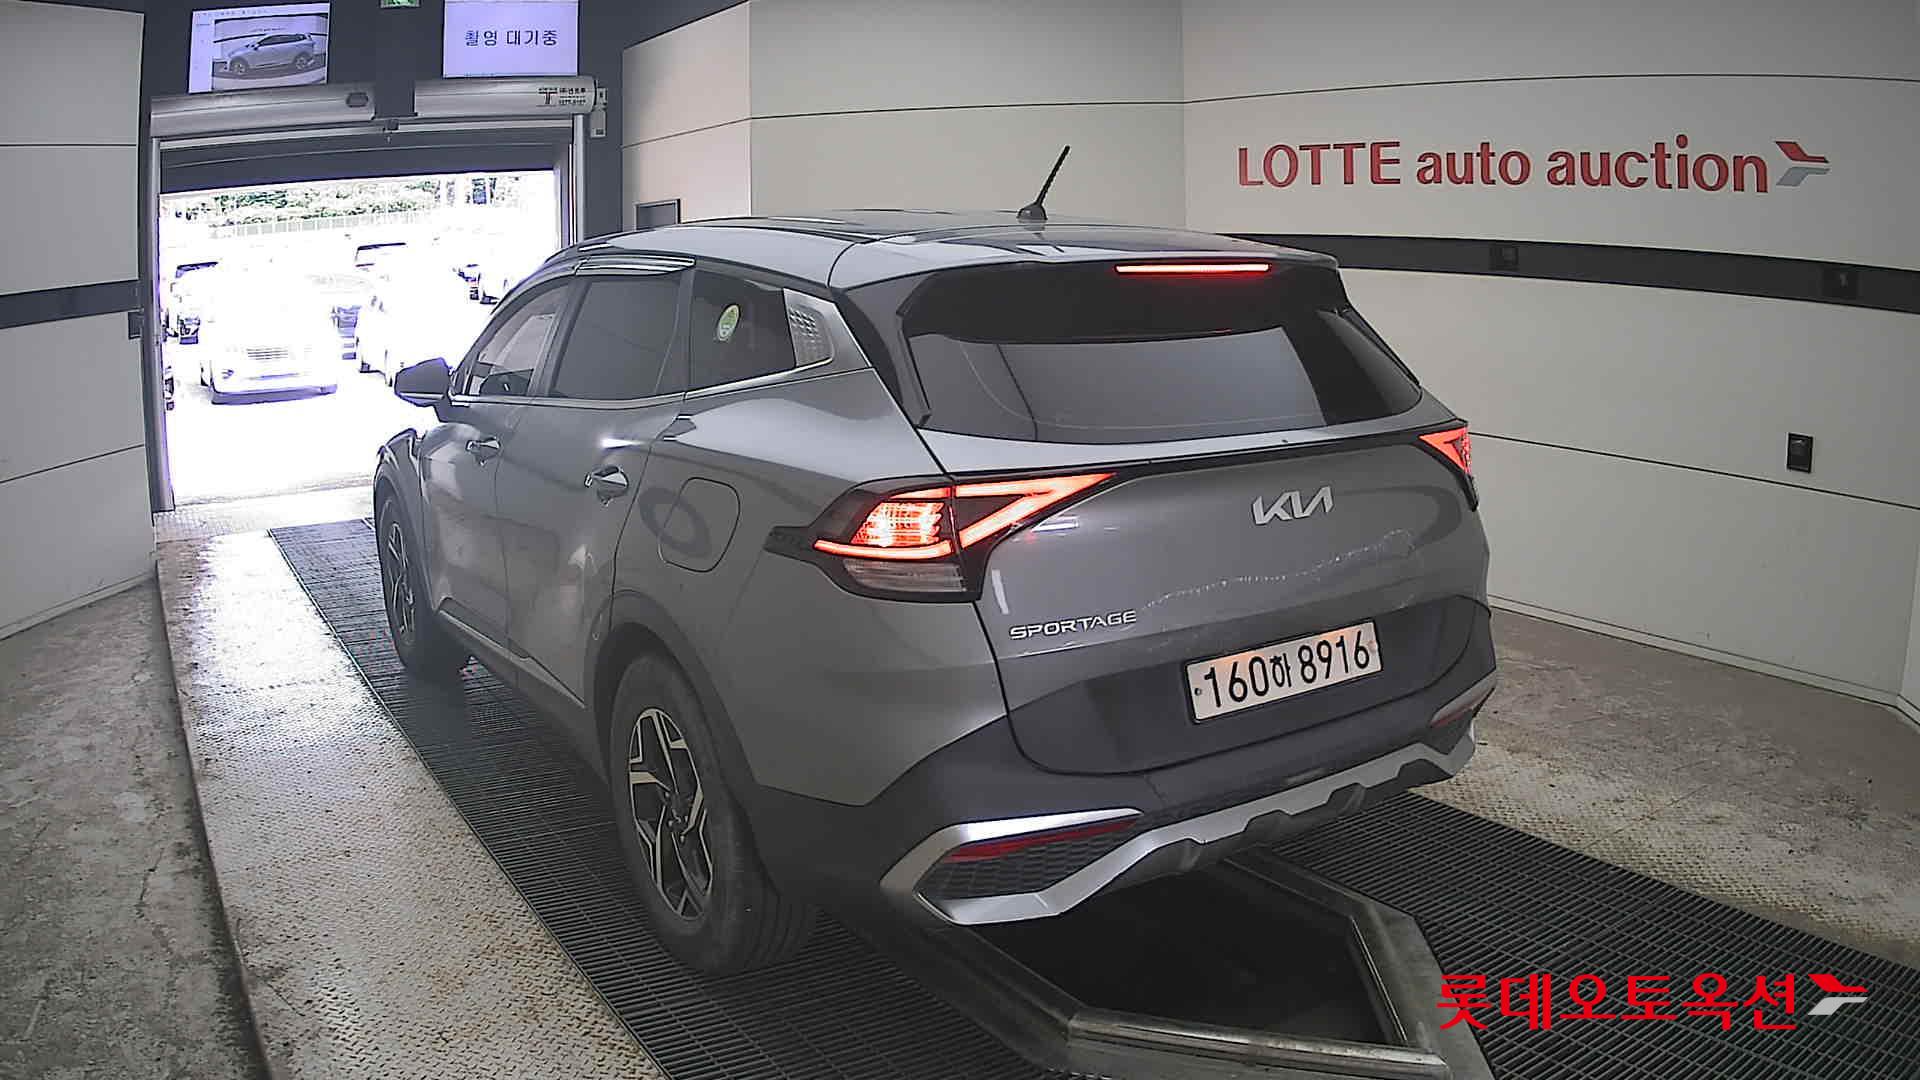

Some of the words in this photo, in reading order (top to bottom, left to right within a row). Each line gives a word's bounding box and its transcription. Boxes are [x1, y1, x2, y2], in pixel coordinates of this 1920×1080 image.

[507, 30, 558, 47] 대기중
[1238, 141, 1401, 187] LOTTE
[1416, 142, 1531, 187] auto
[1546, 134, 1769, 194] auction
[1010, 610, 1138, 640] SPORTAGE
